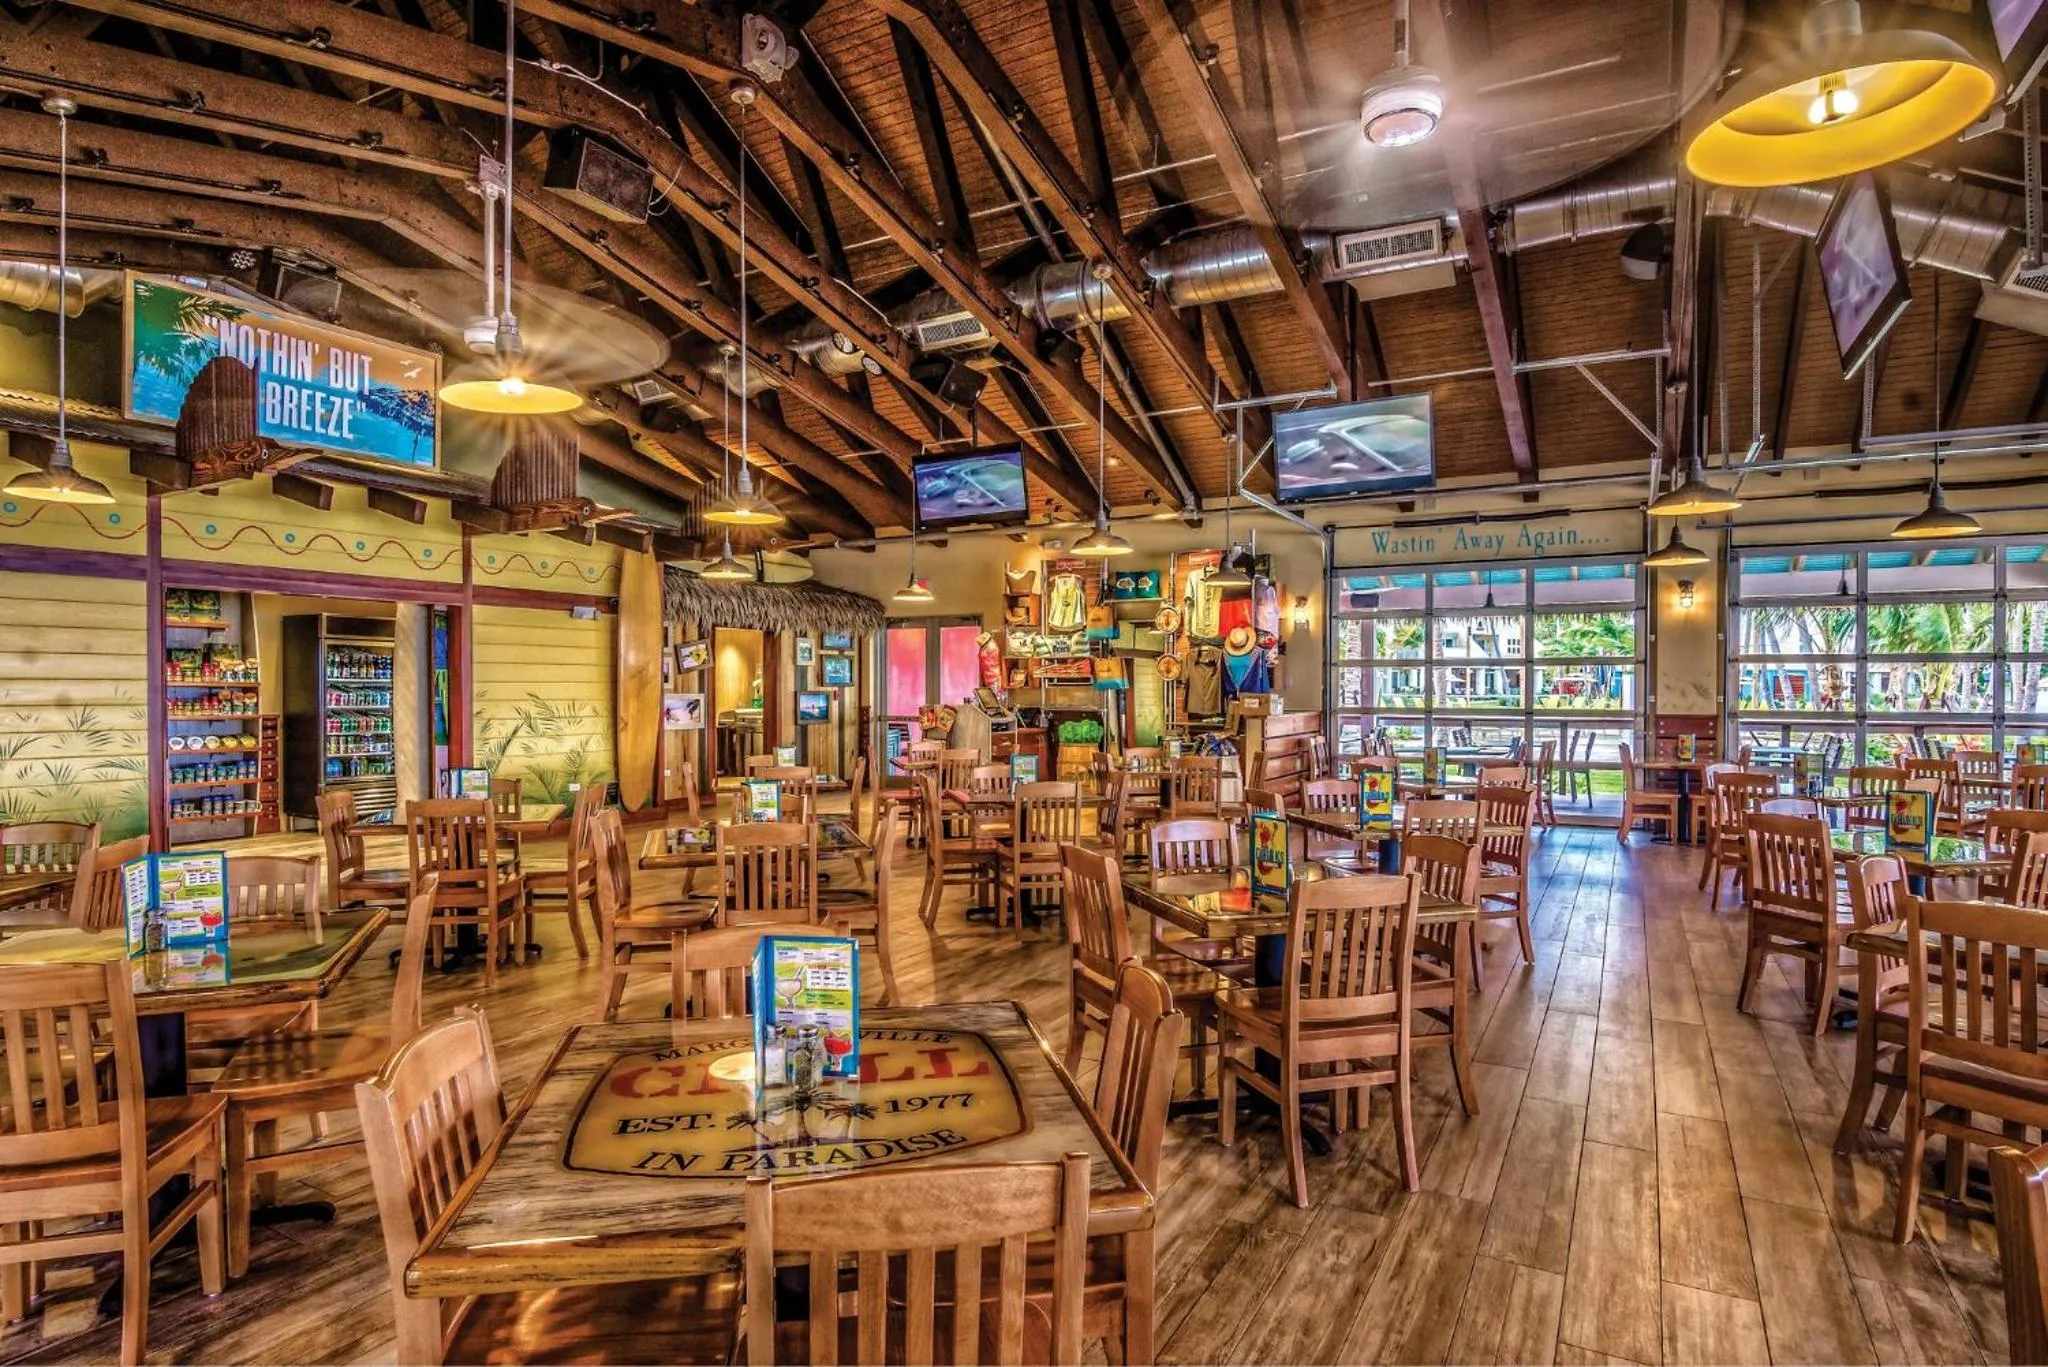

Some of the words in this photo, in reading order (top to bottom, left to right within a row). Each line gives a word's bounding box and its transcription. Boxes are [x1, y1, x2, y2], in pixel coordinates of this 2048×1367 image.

[329, 347, 373, 395] BUT
[265, 381, 367, 439] BREEZE"
[1371, 526, 1443, 555] Wastin'
[1453, 526, 1504, 557] Away
[612, 1113, 716, 1136] EST.
[884, 1092, 977, 1124] 1977
[630, 1151, 704, 1172] IN
[715, 1128, 967, 1172] PARADISE
